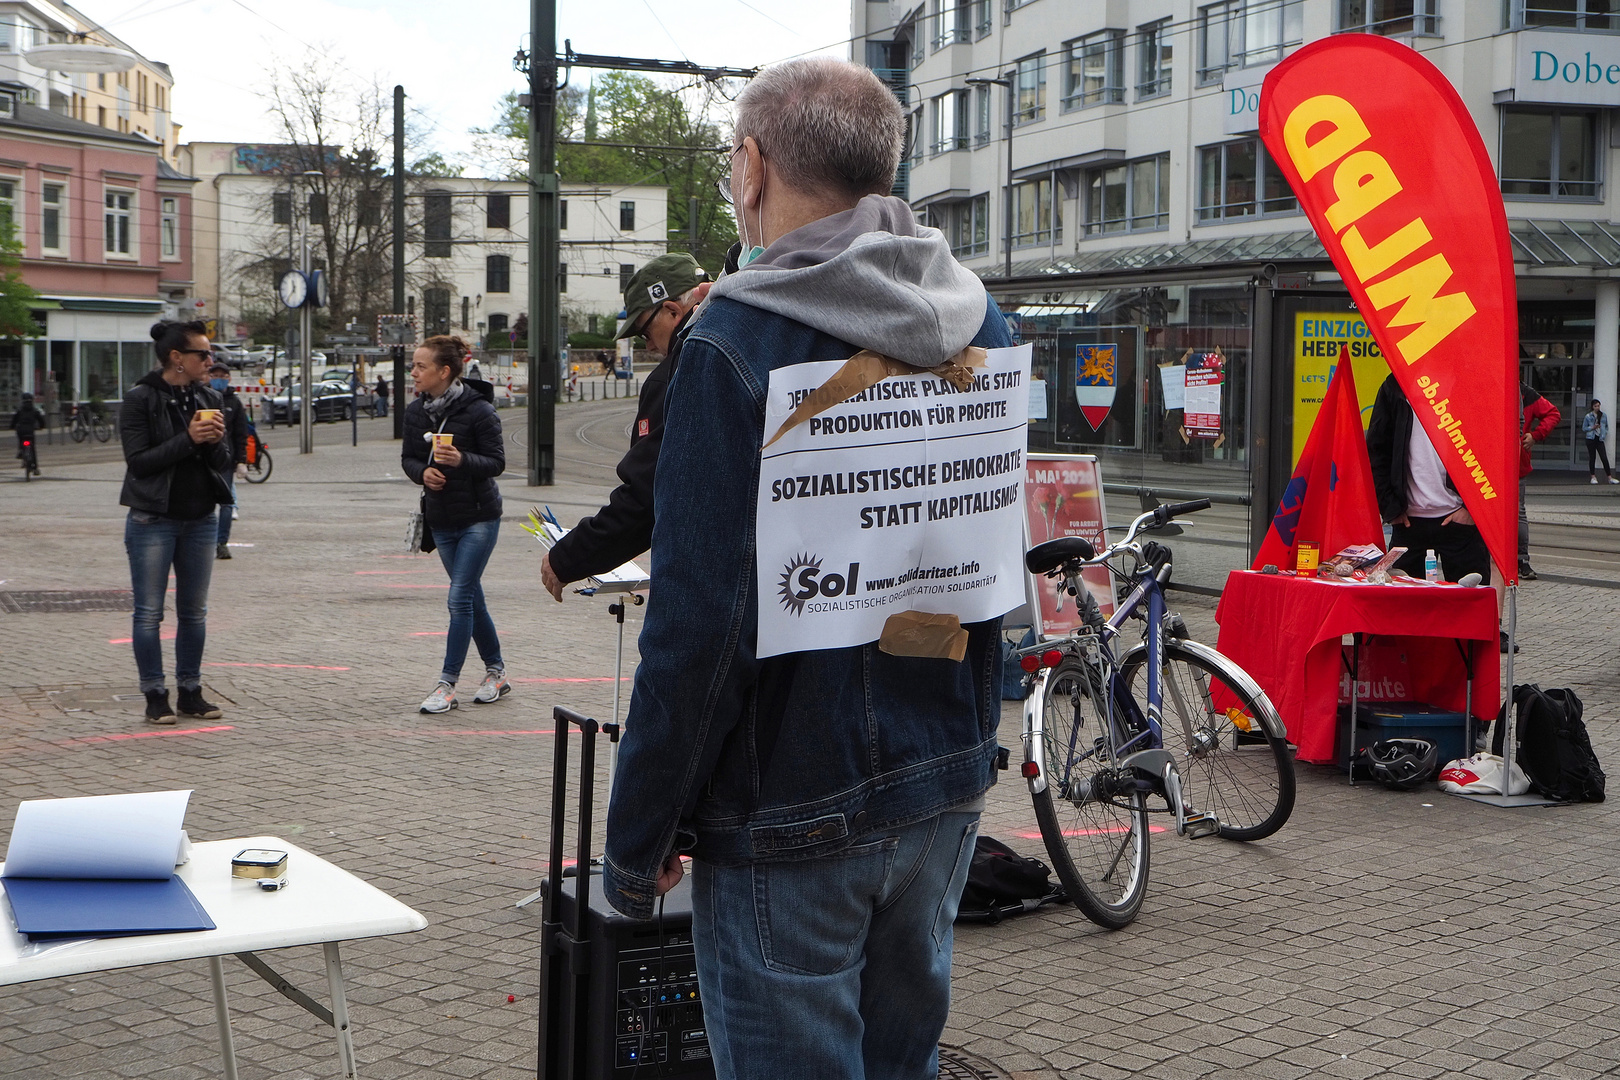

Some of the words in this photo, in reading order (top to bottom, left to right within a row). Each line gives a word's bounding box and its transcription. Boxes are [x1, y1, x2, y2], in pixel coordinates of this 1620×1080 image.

[1531, 51, 1620, 85] Dobe
[1230, 87, 1259, 115] Do
[1302, 340, 1349, 357] HEBT
[1351, 340, 1385, 357] SIC
[787, 380, 918, 410] DEMATISCHE
[993, 370, 1021, 390] STATT
[1301, 375, 1326, 383] LET'S
[809, 409, 923, 436] PRODUKTION
[926, 403, 955, 426] FÜR
[959, 400, 1007, 422] PROFITE
[771, 463, 937, 502] SOZIALISTISCHE
[941, 448, 1022, 484] DEMOKRATIE
[860, 501, 922, 529] STATT
[927, 482, 1019, 522] KAPITALISMUS
[795, 562, 860, 600] Sol
[865, 560, 980, 592] www.solidaritaet.info
[807, 595, 887, 614] SOZIALISTISCHE
[889, 584, 945, 604] ORGANISATION
[947, 575, 993, 593] SOLIDARITÄT
